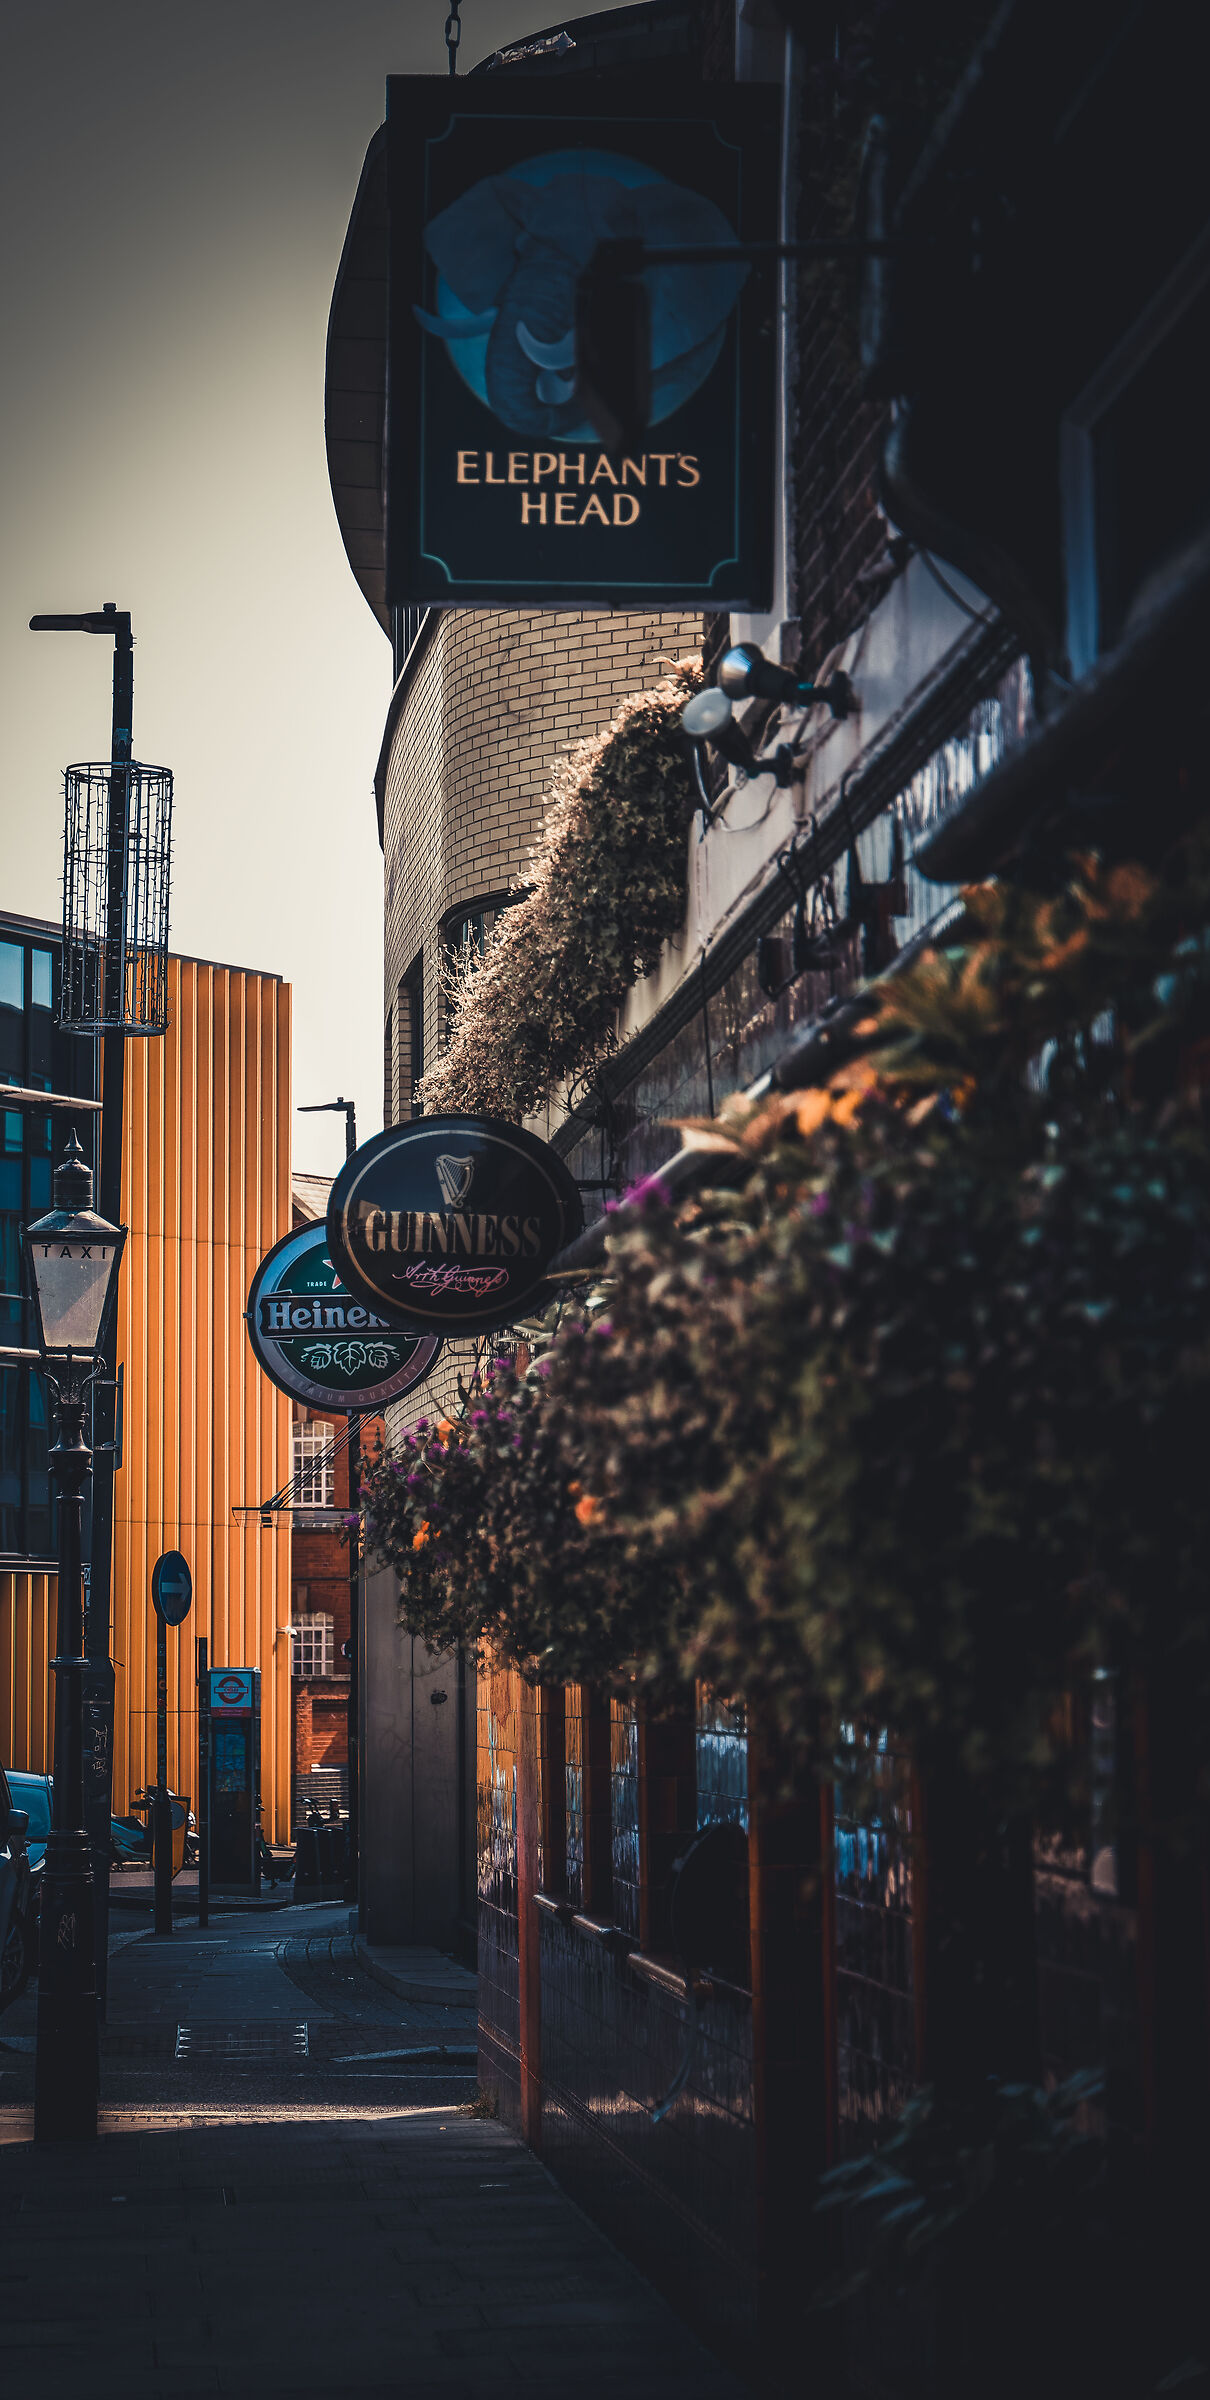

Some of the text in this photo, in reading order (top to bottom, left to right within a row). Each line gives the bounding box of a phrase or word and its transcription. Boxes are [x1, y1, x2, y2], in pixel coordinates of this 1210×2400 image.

[457, 451, 700, 487] ELEPHANT'S
[521, 492, 640, 526] HEAD
[365, 1210, 541, 1257] GUINNESS
[41, 1244, 107, 1259] TAXI
